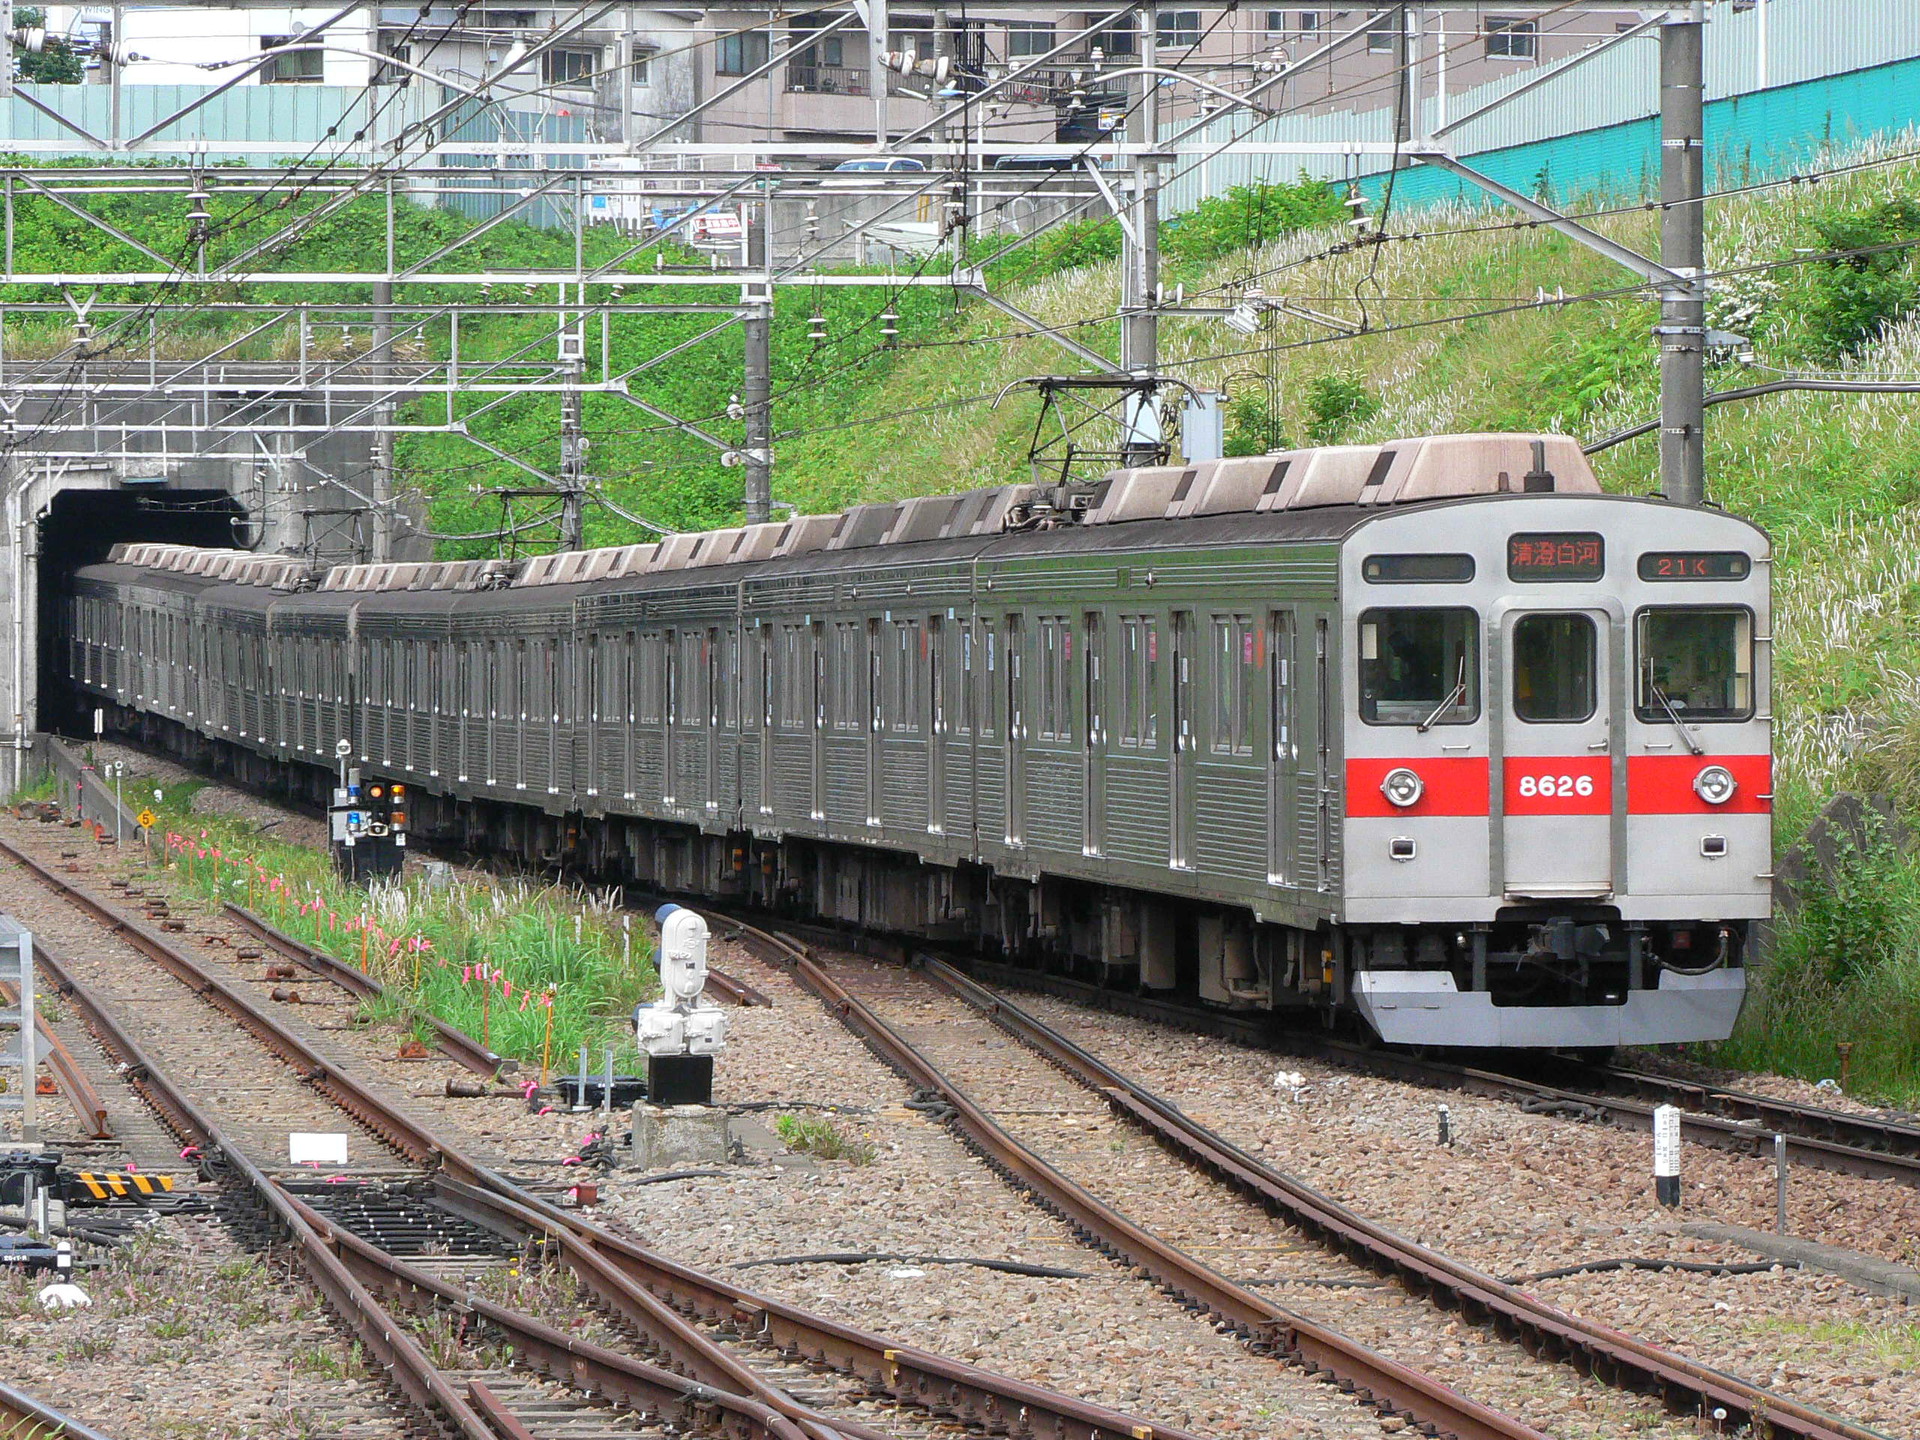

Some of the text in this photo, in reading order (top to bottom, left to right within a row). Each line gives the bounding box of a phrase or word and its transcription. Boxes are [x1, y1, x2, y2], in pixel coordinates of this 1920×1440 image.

[1512, 541, 1599, 565] 清澄白河
[1658, 558, 1707, 575] 21K
[1519, 775, 1594, 797] 8626
[142, 813, 149, 825] 5
